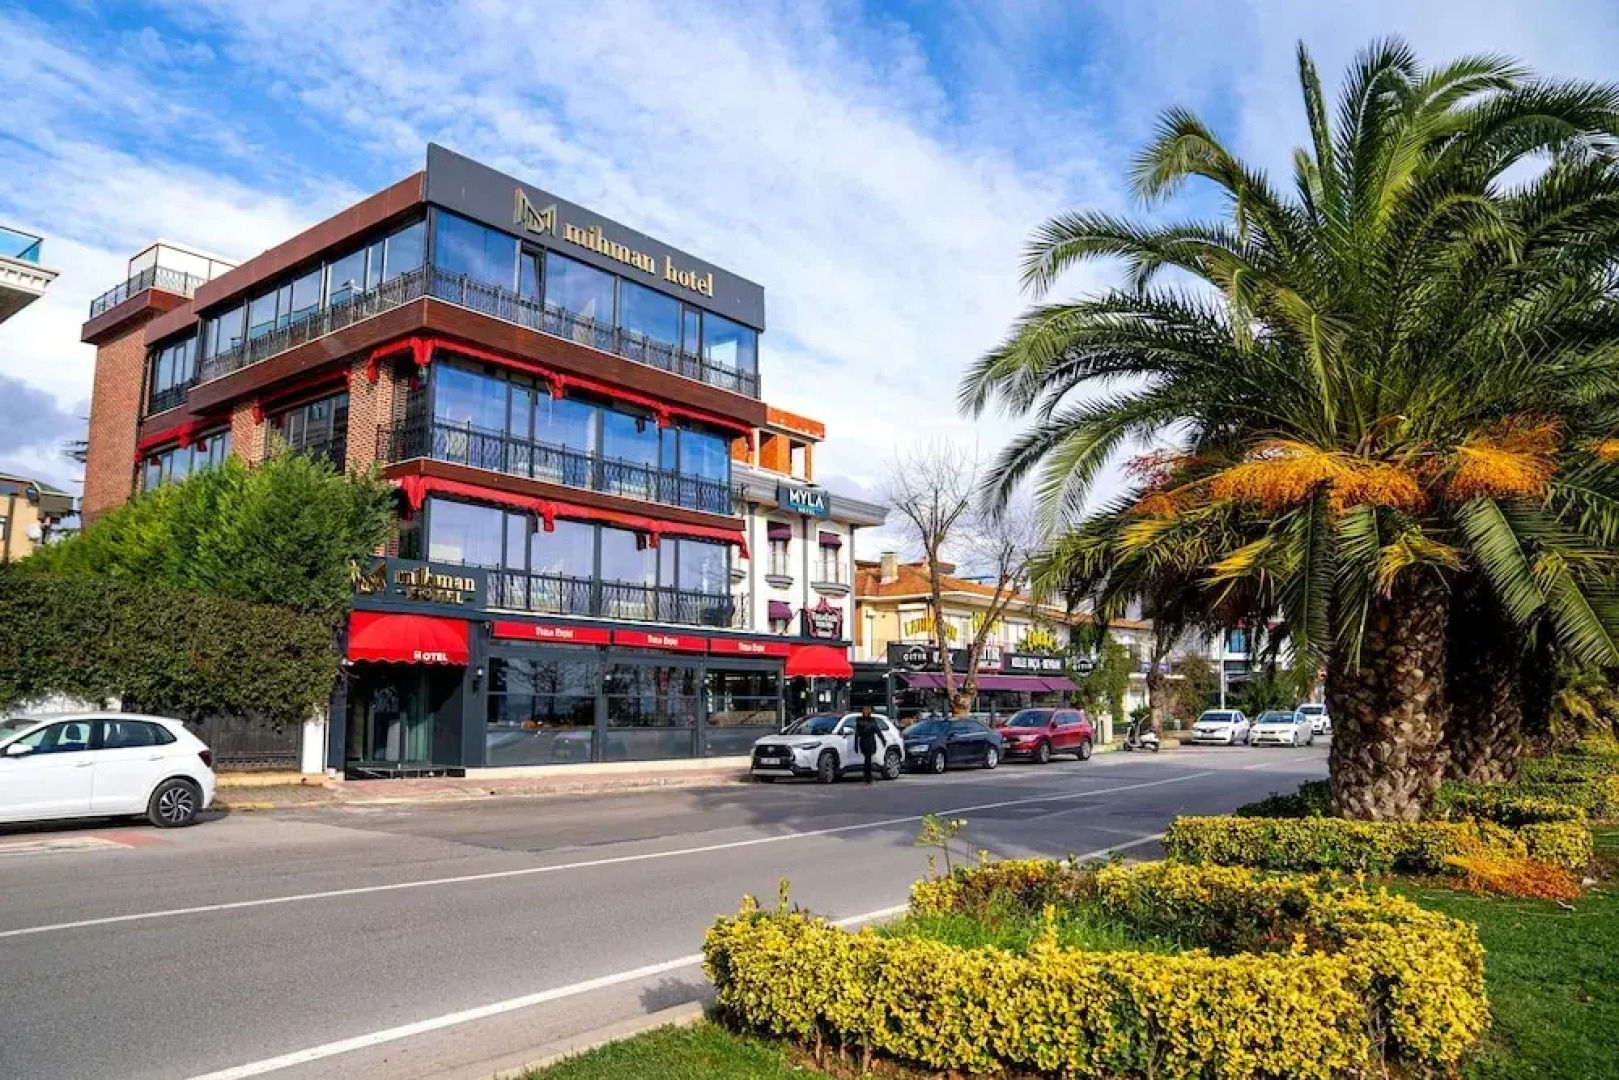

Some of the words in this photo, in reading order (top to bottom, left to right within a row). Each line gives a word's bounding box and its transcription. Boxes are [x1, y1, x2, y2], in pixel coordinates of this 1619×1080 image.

[562, 221, 656, 275] mihman
[662, 254, 713, 298] hotel
[789, 487, 825, 510] MYLA
[394, 566, 476, 592] mihman
[413, 650, 449, 662] HOTEL
